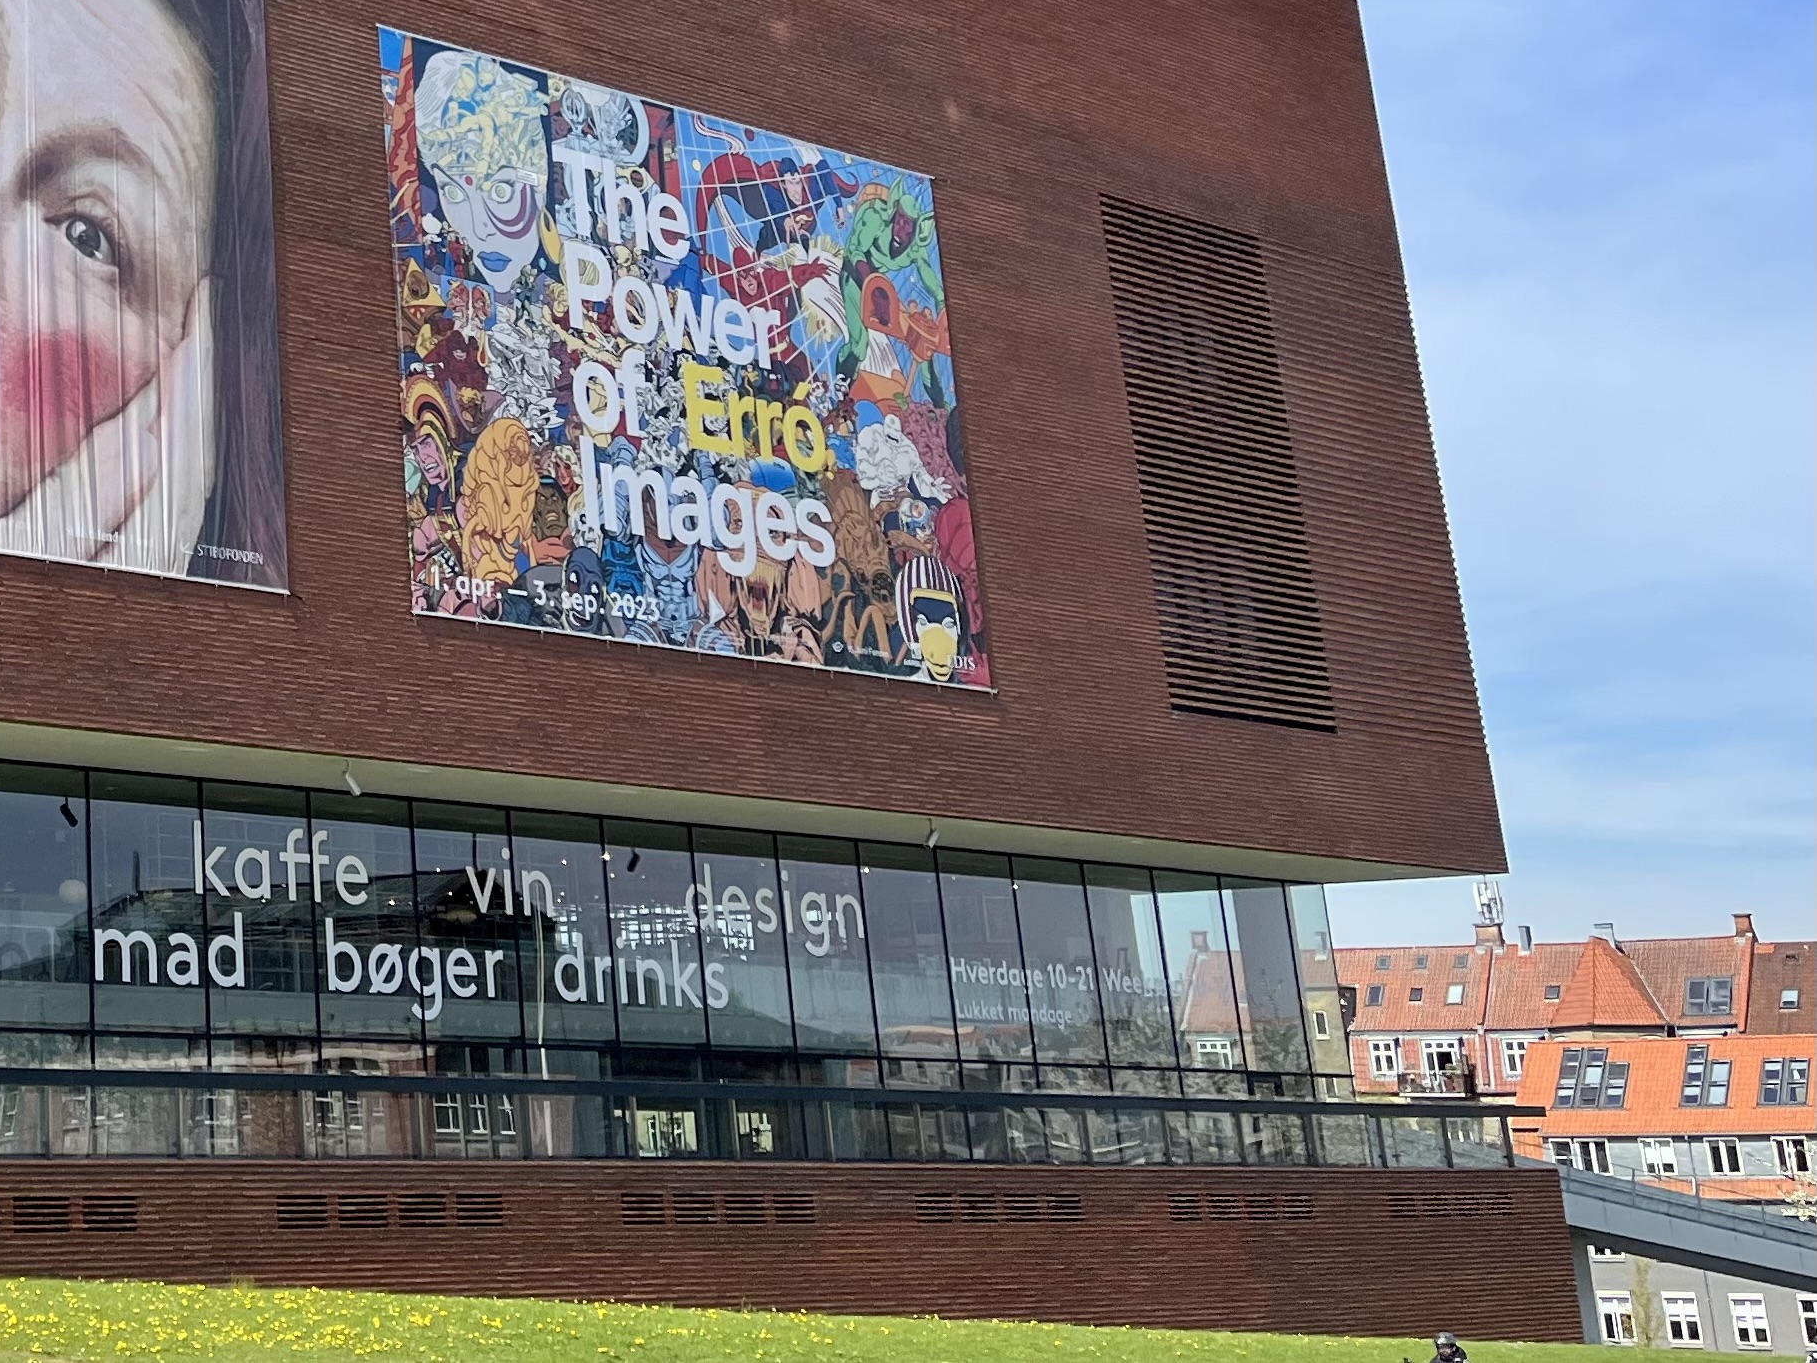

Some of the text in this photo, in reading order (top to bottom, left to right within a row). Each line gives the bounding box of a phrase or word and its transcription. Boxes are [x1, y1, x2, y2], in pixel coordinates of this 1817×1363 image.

[552, 144, 690, 260] The
[562, 241, 780, 369] Power
[573, 349, 827, 472] of Erró
[579, 435, 836, 577] Images
[431, 565, 450, 592] 1.
[455, 575, 503, 603] apr.
[533, 580, 555, 607] 3.
[561, 591, 605, 620] sep.
[611, 592, 660, 622] 2023
[193, 820, 865, 957] kaffe vin design
[94, 912, 729, 1021] mad bøger drinks
[950, 956, 1044, 995] Hverdage
[1047, 963, 1095, 991] 10-21
[955, 999, 1072, 1030] Lukket mandage
